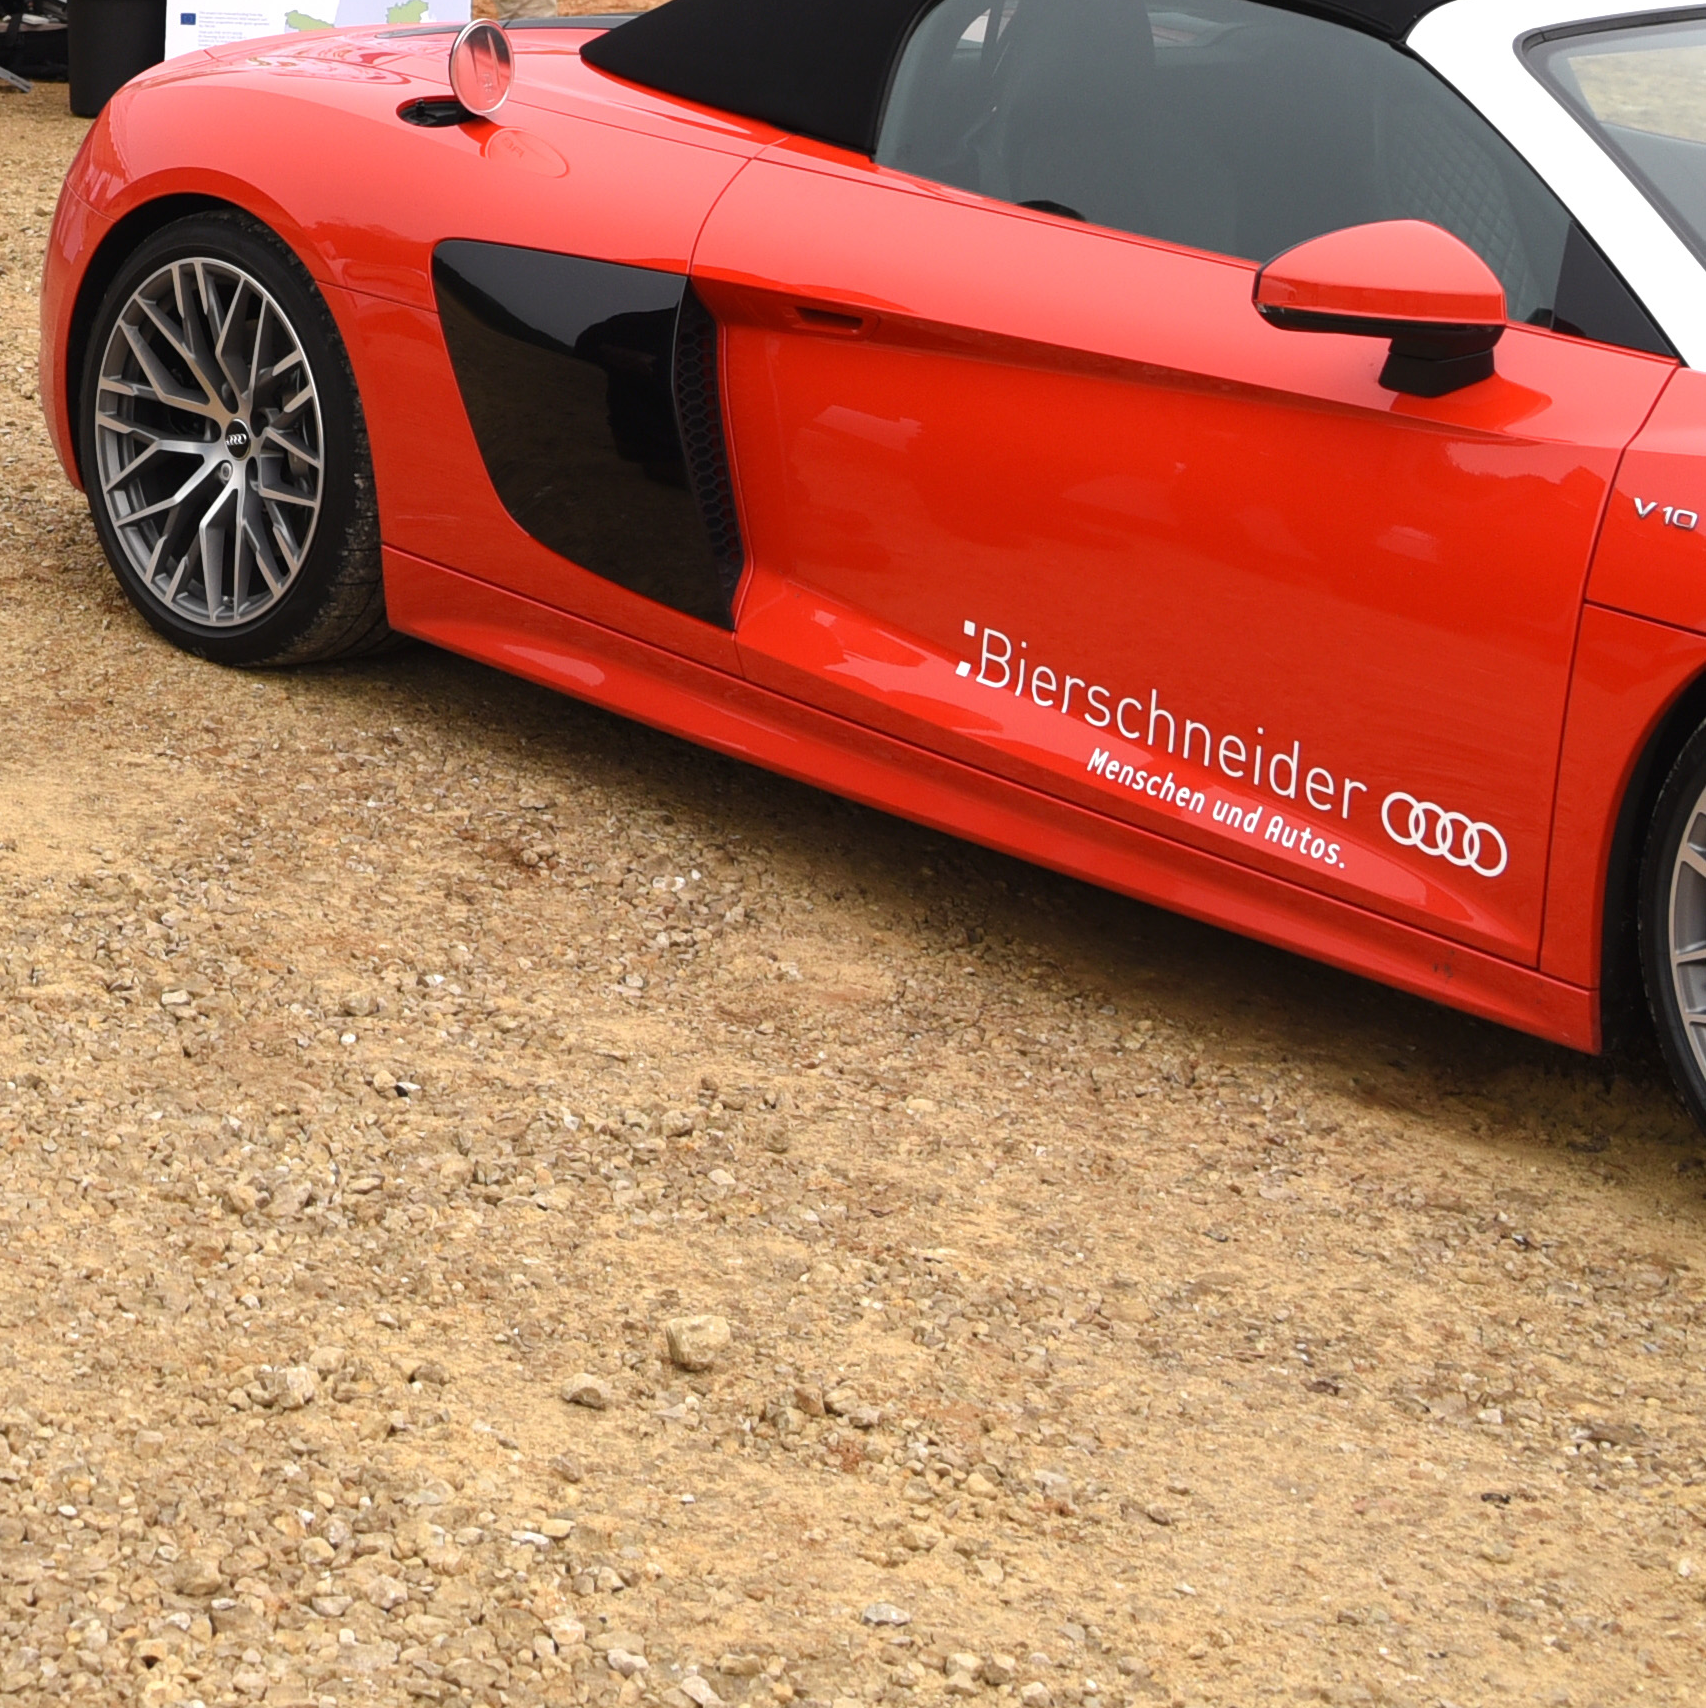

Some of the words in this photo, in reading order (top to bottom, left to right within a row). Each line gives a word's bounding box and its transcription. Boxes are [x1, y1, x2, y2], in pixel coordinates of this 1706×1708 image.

[1086, 746, 1206, 815] Menschen
[1211, 798, 1260, 835] und
[1264, 815, 1347, 869] Autos.
